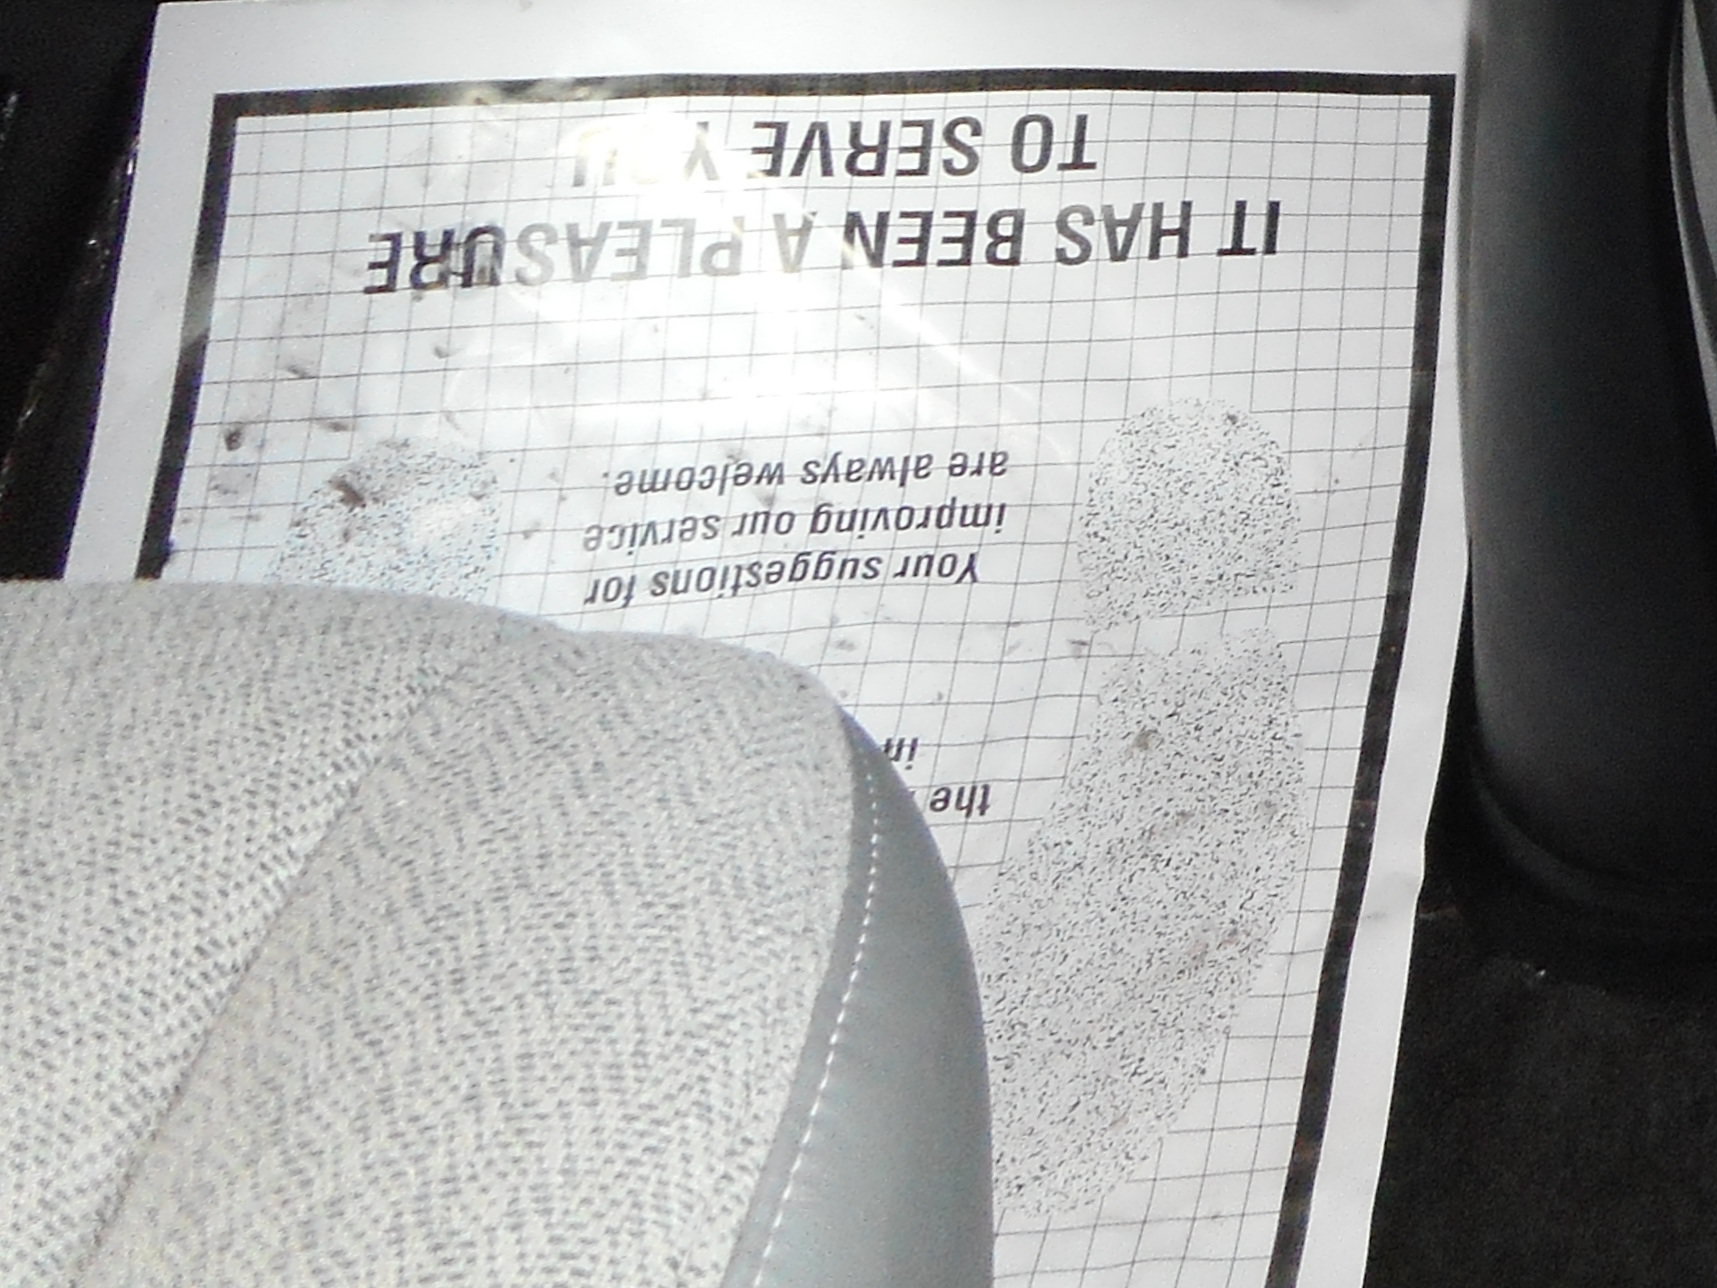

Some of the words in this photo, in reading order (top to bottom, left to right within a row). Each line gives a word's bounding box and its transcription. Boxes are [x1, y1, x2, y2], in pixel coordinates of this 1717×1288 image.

[572, 121, 720, 188] YU
[749, 116, 983, 178] SERVE
[1010, 113, 1098, 174] TO
[773, 211, 818, 273] A
[841, 208, 1026, 270] BEEN
[1054, 200, 1193, 265] HAS
[1216, 200, 1281, 257] IT
[363, 216, 746, 294] PLEASURE
[601, 461, 785, 497] welcome.
[801, 451, 933, 488] always
[947, 450, 1009, 478] are
[582, 515, 721, 557] service
[731, 512, 797, 537] our
[808, 501, 1008, 540] improving
[649, 551, 882, 600] suggestions
[893, 552, 981, 584] Your
[583, 573, 638, 609] for
[929, 783, 992, 819] the
